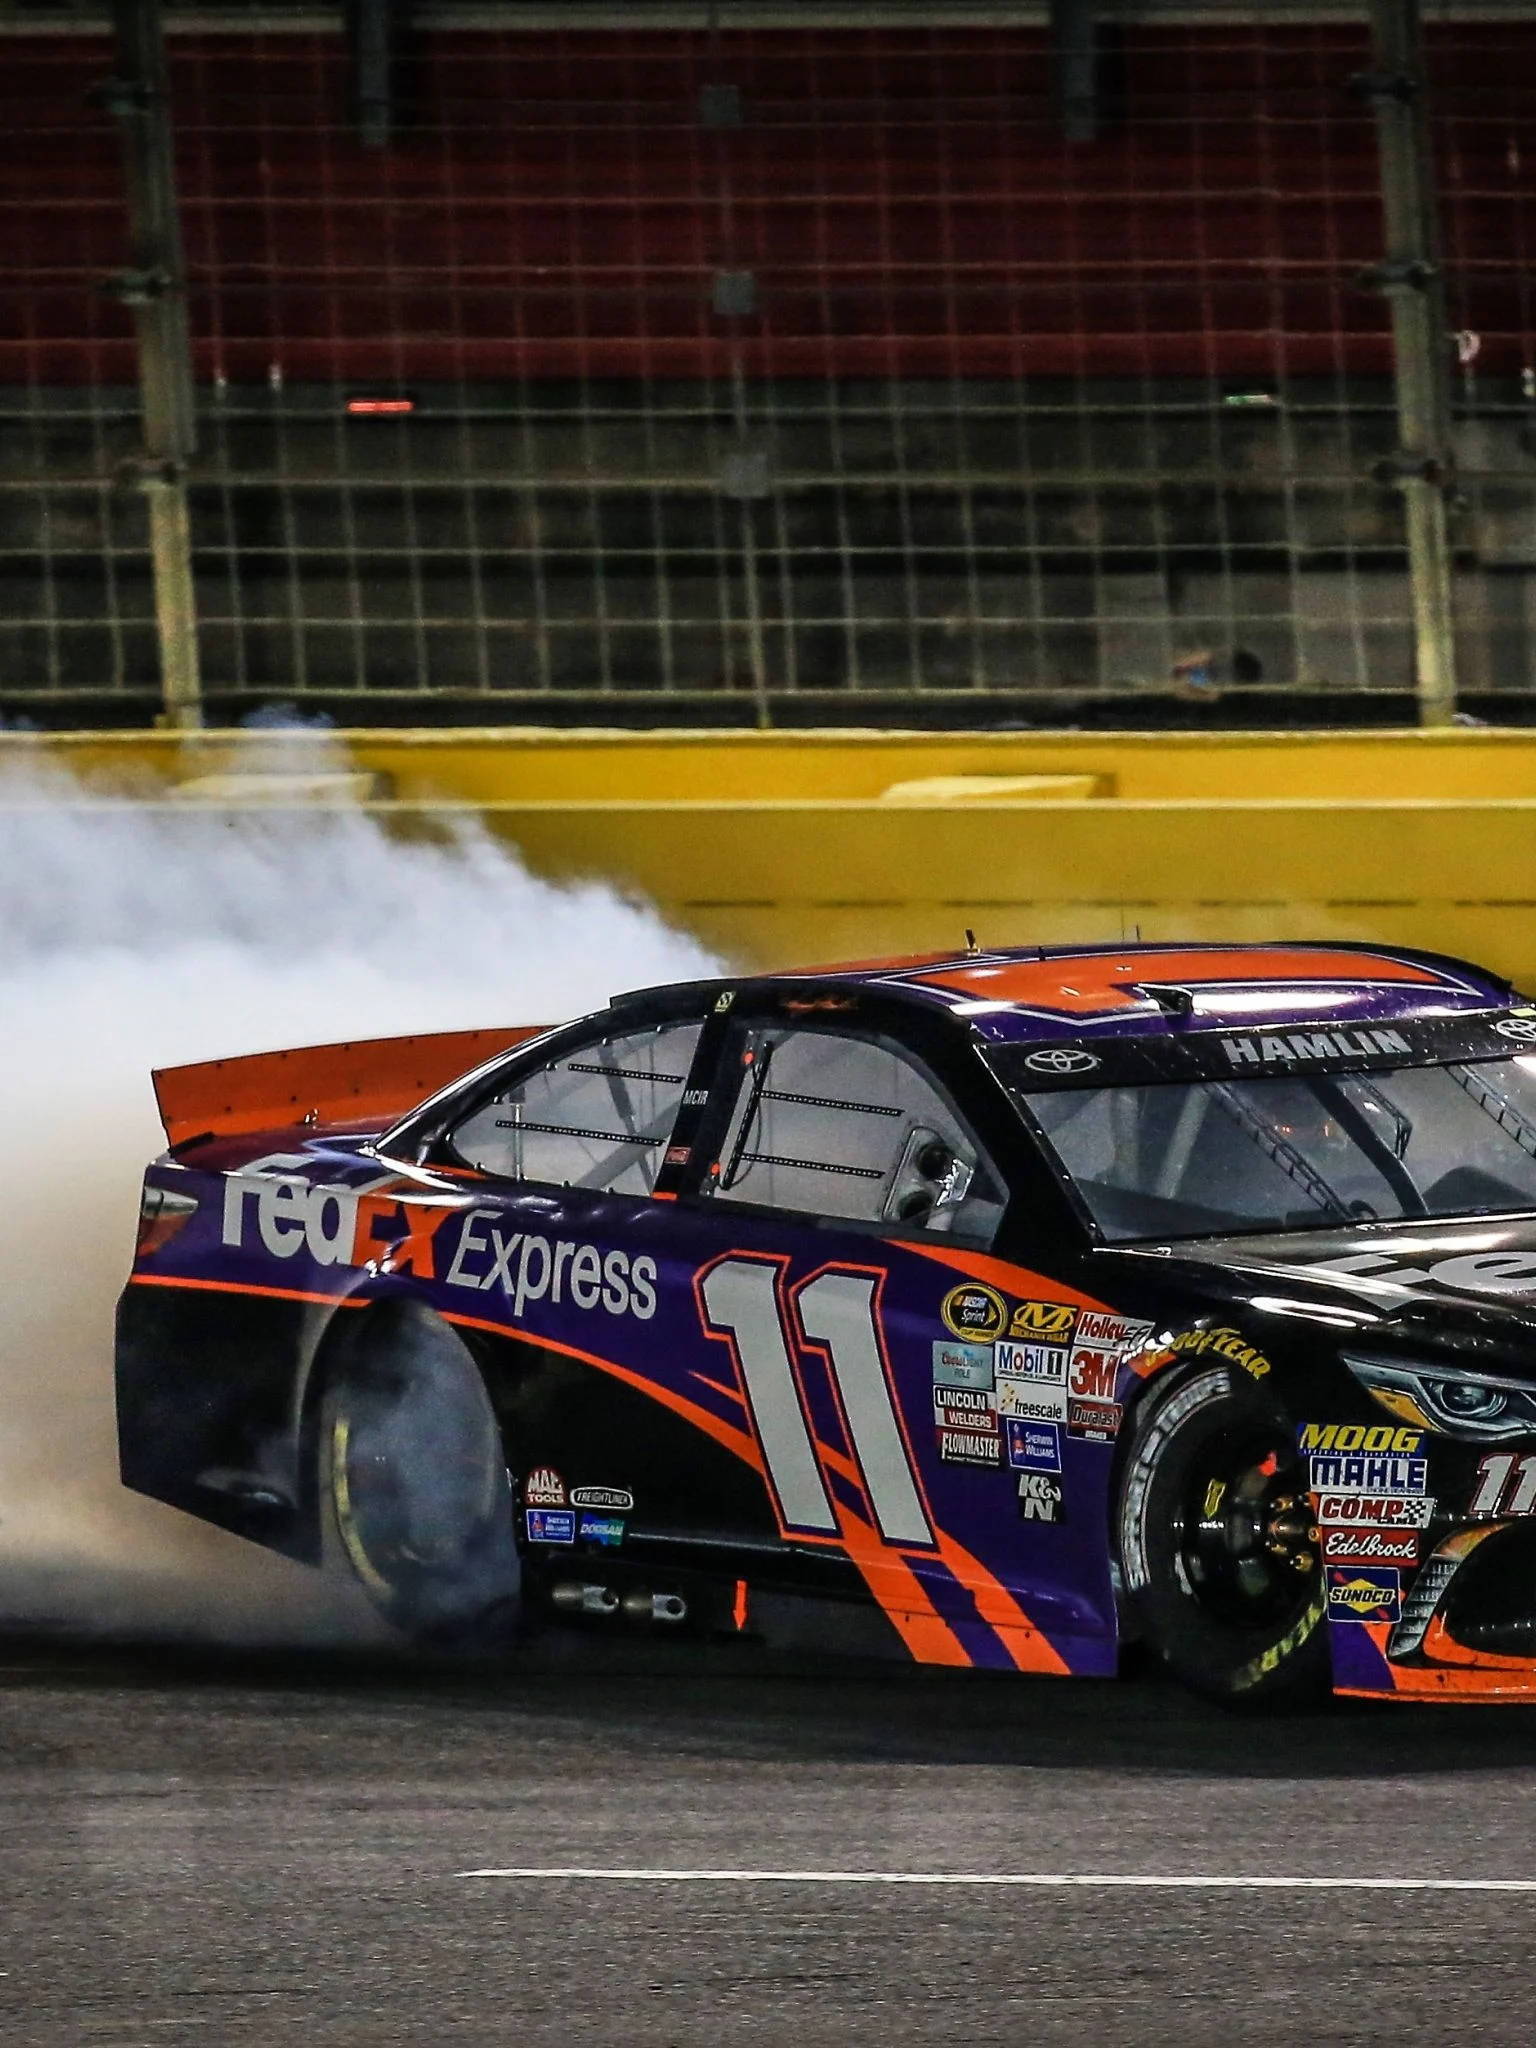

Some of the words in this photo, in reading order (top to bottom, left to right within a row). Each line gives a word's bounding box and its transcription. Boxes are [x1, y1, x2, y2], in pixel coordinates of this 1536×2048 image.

[1220, 1029, 1413, 1063] HAMLIN
[220, 1152, 463, 1280] FedEx
[445, 1210, 658, 1320] Express
[961, 1308, 986, 1324] Sprint
[1078, 1313, 1126, 1341] Holley
[999, 1344, 1044, 1373] Mobil
[1144, 1327, 1272, 1381] ODYEAR
[1069, 1350, 1120, 1398] 3M
[698, 1256, 937, 1549] 11
[937, 1388, 986, 1411] LINCOLN
[1014, 1398, 1062, 1419] freescale
[948, 1411, 992, 1429] WELDERS
[941, 1432, 1000, 1460] FLOWMASTER
[1300, 1423, 1425, 1452] MOOG
[1311, 1459, 1425, 1489] MAHLE
[1471, 1455, 1536, 1512] 11
[527, 1493, 564, 1503] TOOLS
[1322, 1498, 1406, 1521] COMP
[1325, 1532, 1417, 1558] Edelbrock
[1331, 1588, 1394, 1604] SUNOCO
